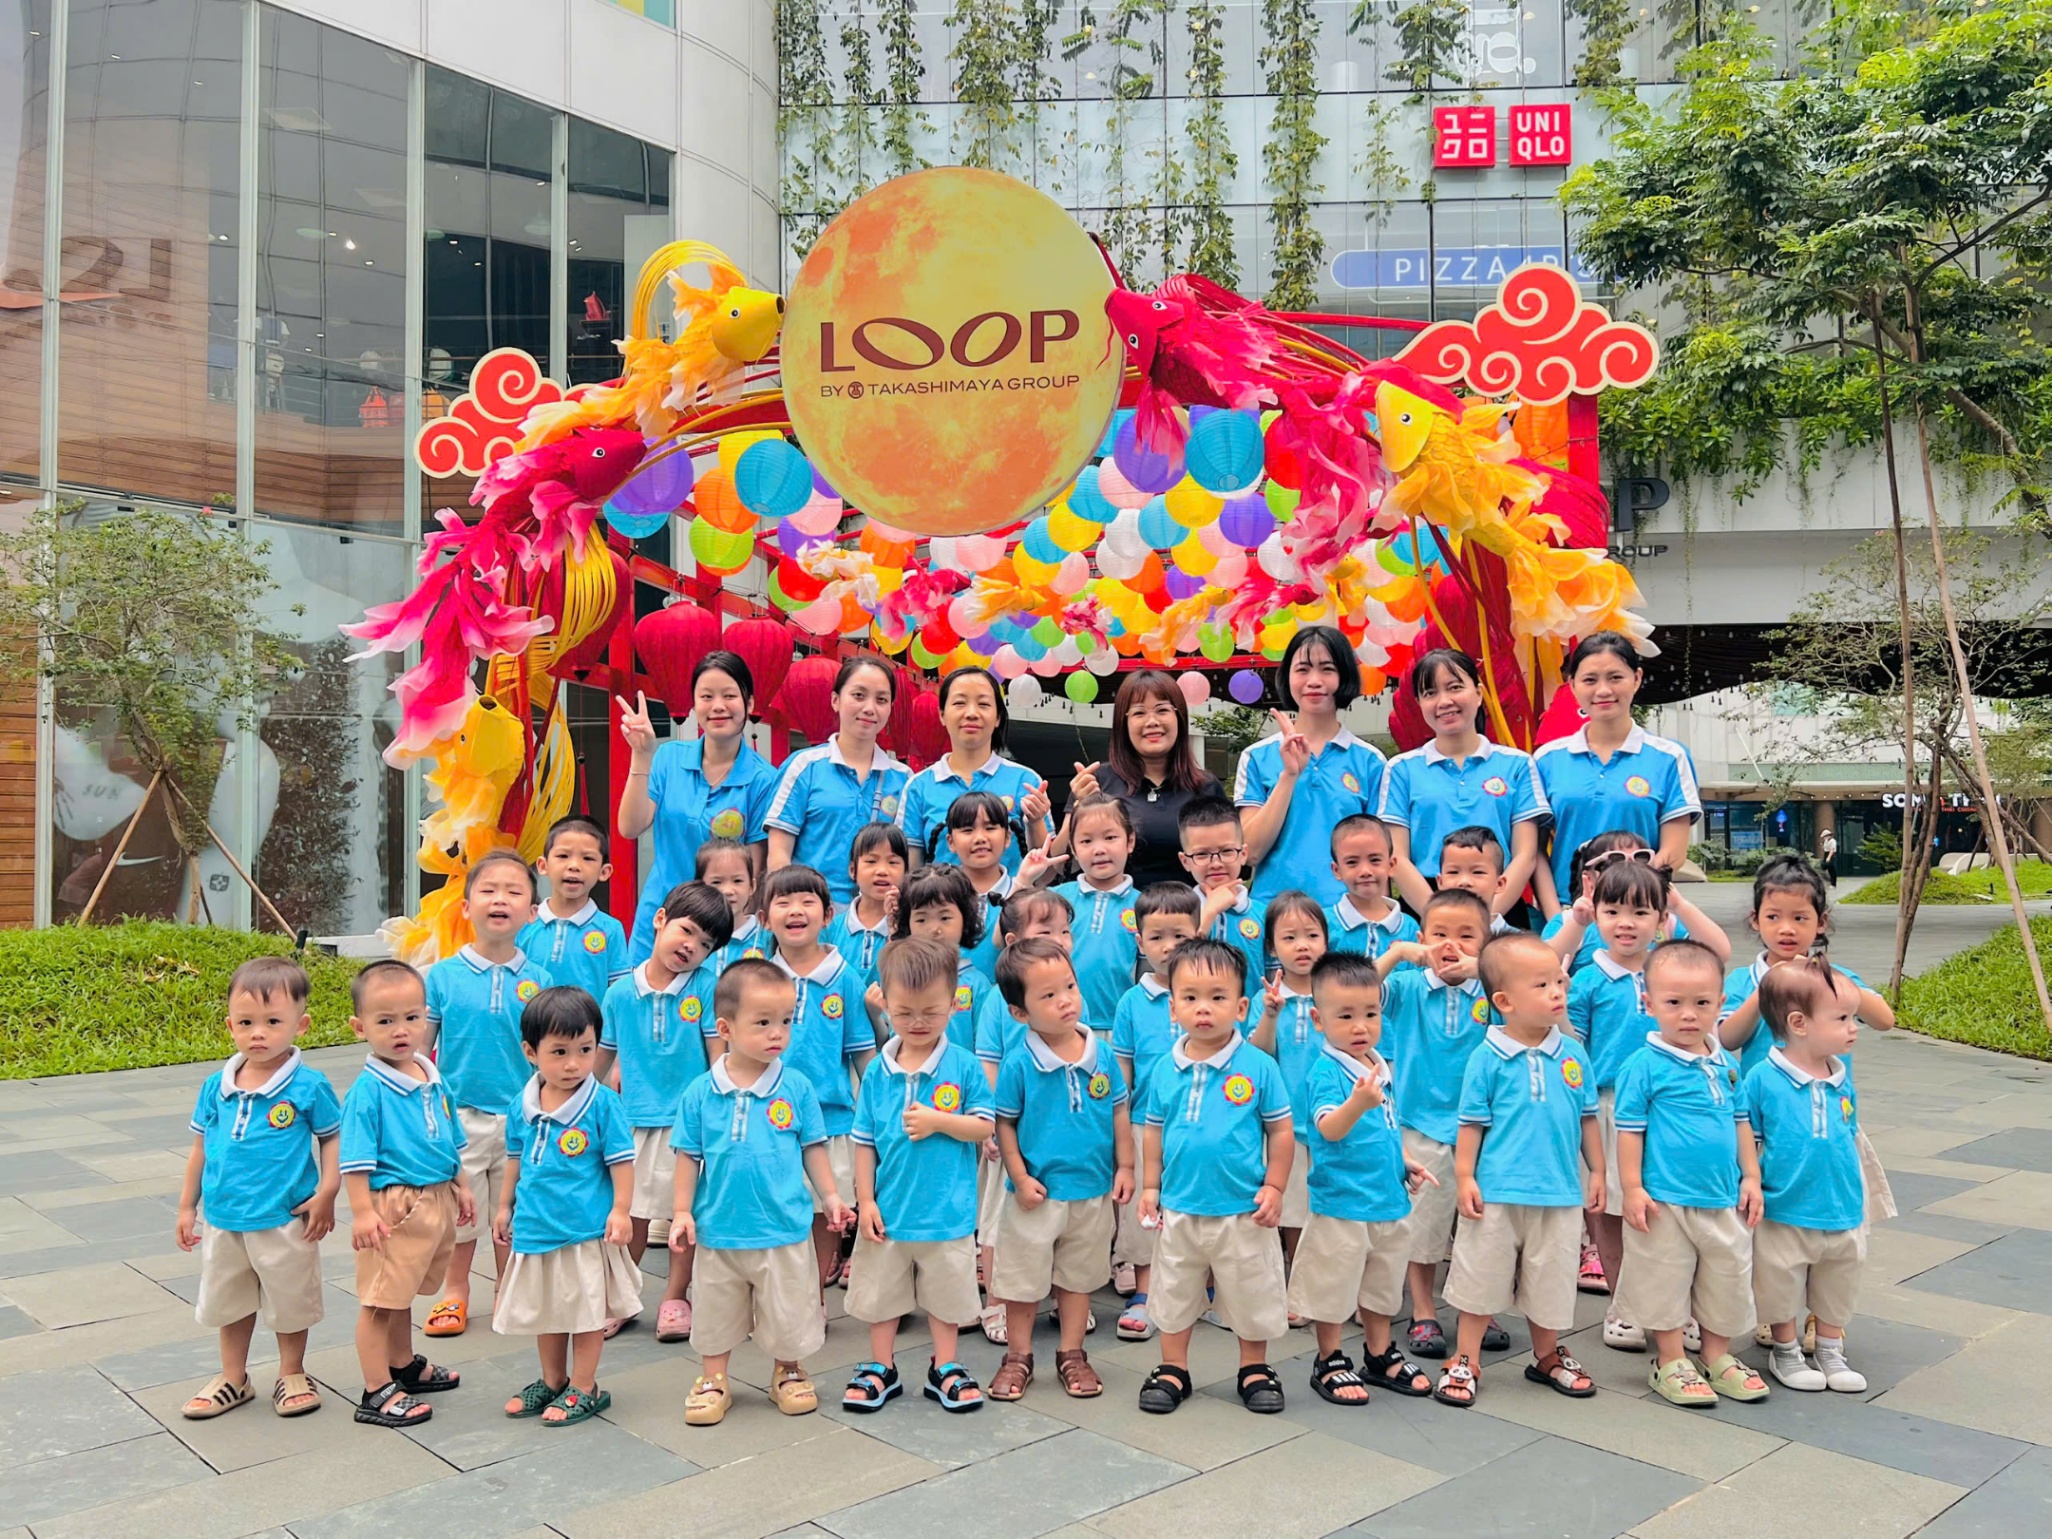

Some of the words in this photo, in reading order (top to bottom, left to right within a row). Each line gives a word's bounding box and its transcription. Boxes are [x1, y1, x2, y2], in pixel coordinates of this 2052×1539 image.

[1516, 111, 1560, 133] UNI
[1517, 135, 1565, 161] QLO
[1394, 255, 1507, 282] PIZZA
[820, 309, 1080, 372] LOOP
[820, 385, 844, 398] BY
[868, 378, 1004, 396] TAKASHIMAYA
[1007, 375, 1080, 391] GROUP
[1608, 544, 1669, 561] ROUP
